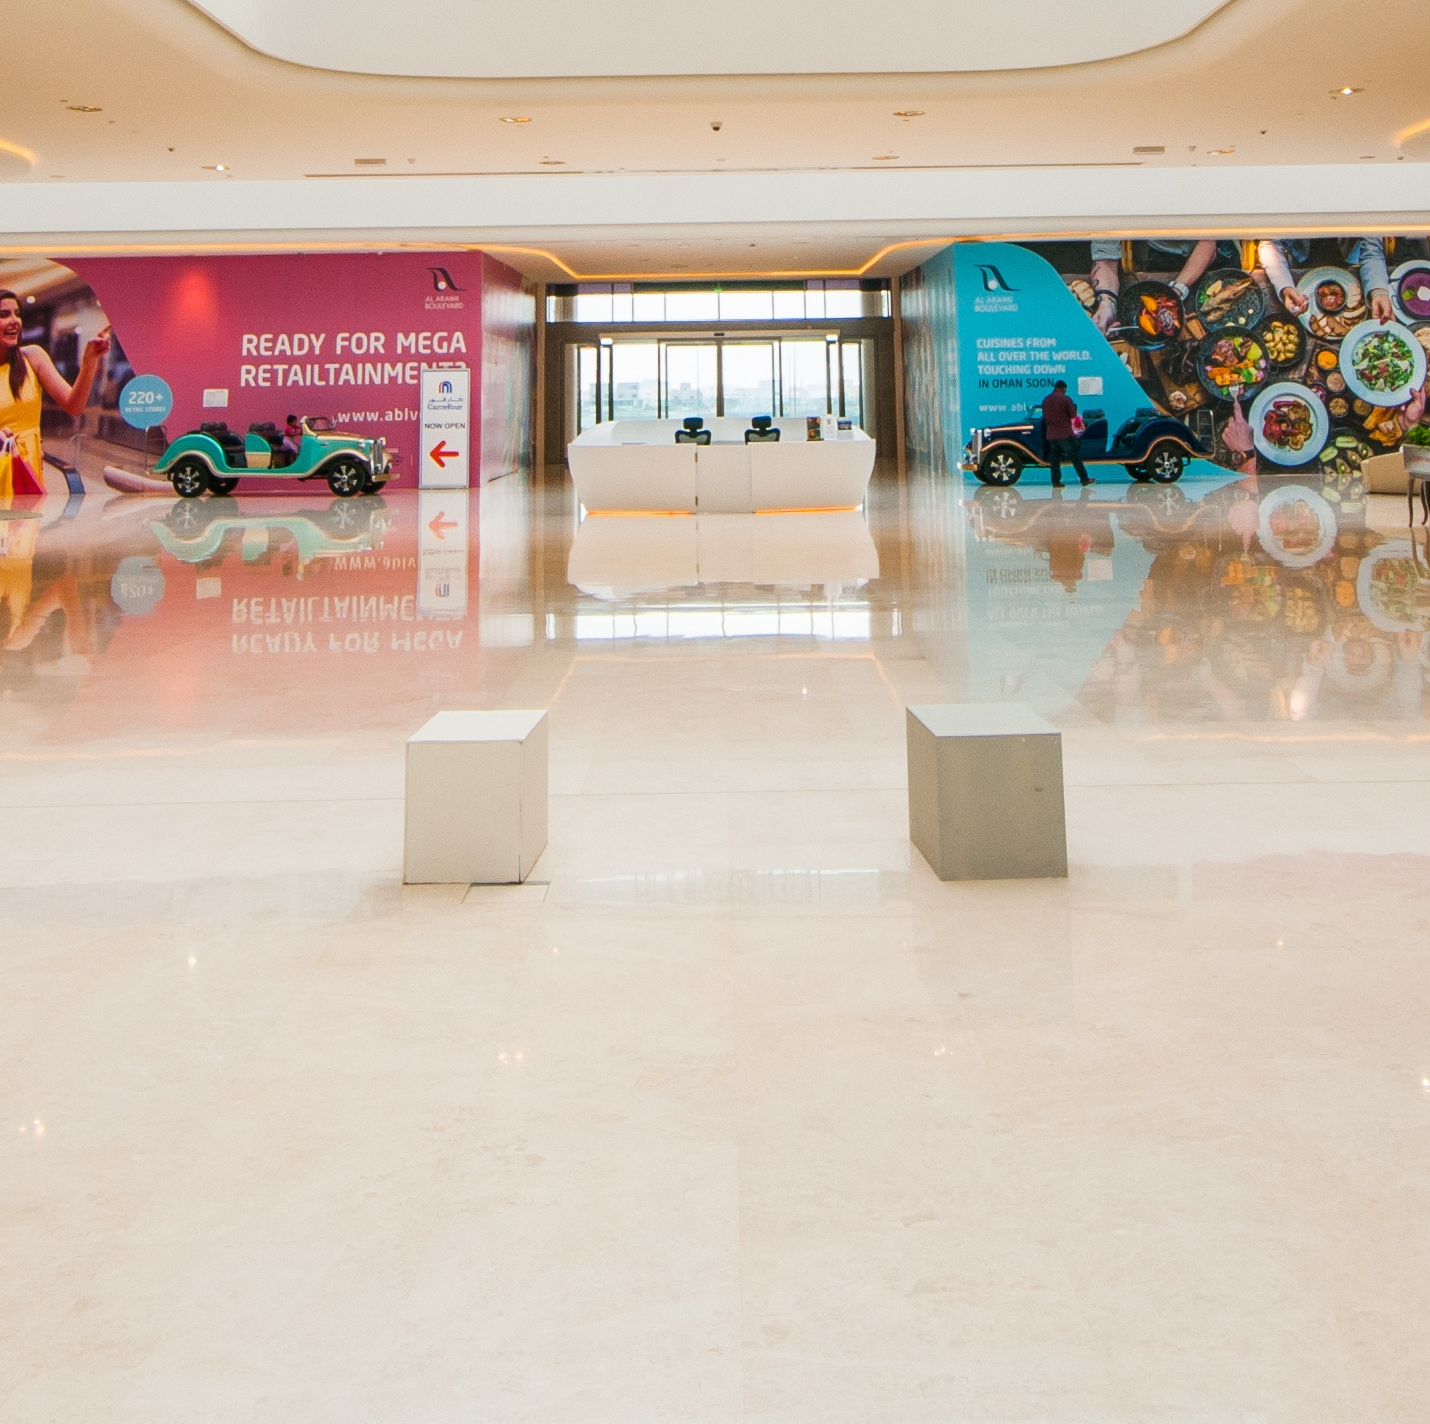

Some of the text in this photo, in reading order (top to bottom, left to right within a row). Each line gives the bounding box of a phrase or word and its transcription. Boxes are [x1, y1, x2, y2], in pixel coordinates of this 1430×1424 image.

[241, 331, 467, 357] READY FOR MEGA
[976, 337, 1057, 348] CUISINES FROM
[977, 351, 996, 362] ALL
[998, 351, 1027, 361] OVER
[1030, 350, 1050, 361] THE
[240, 361, 467, 387] RETAILTAINME
[977, 365, 1066, 375] TOUCHING DOWN
[978, 379, 989, 388] IN
[992, 378, 1022, 388] OMAN
[128, 391, 164, 404] 220+
